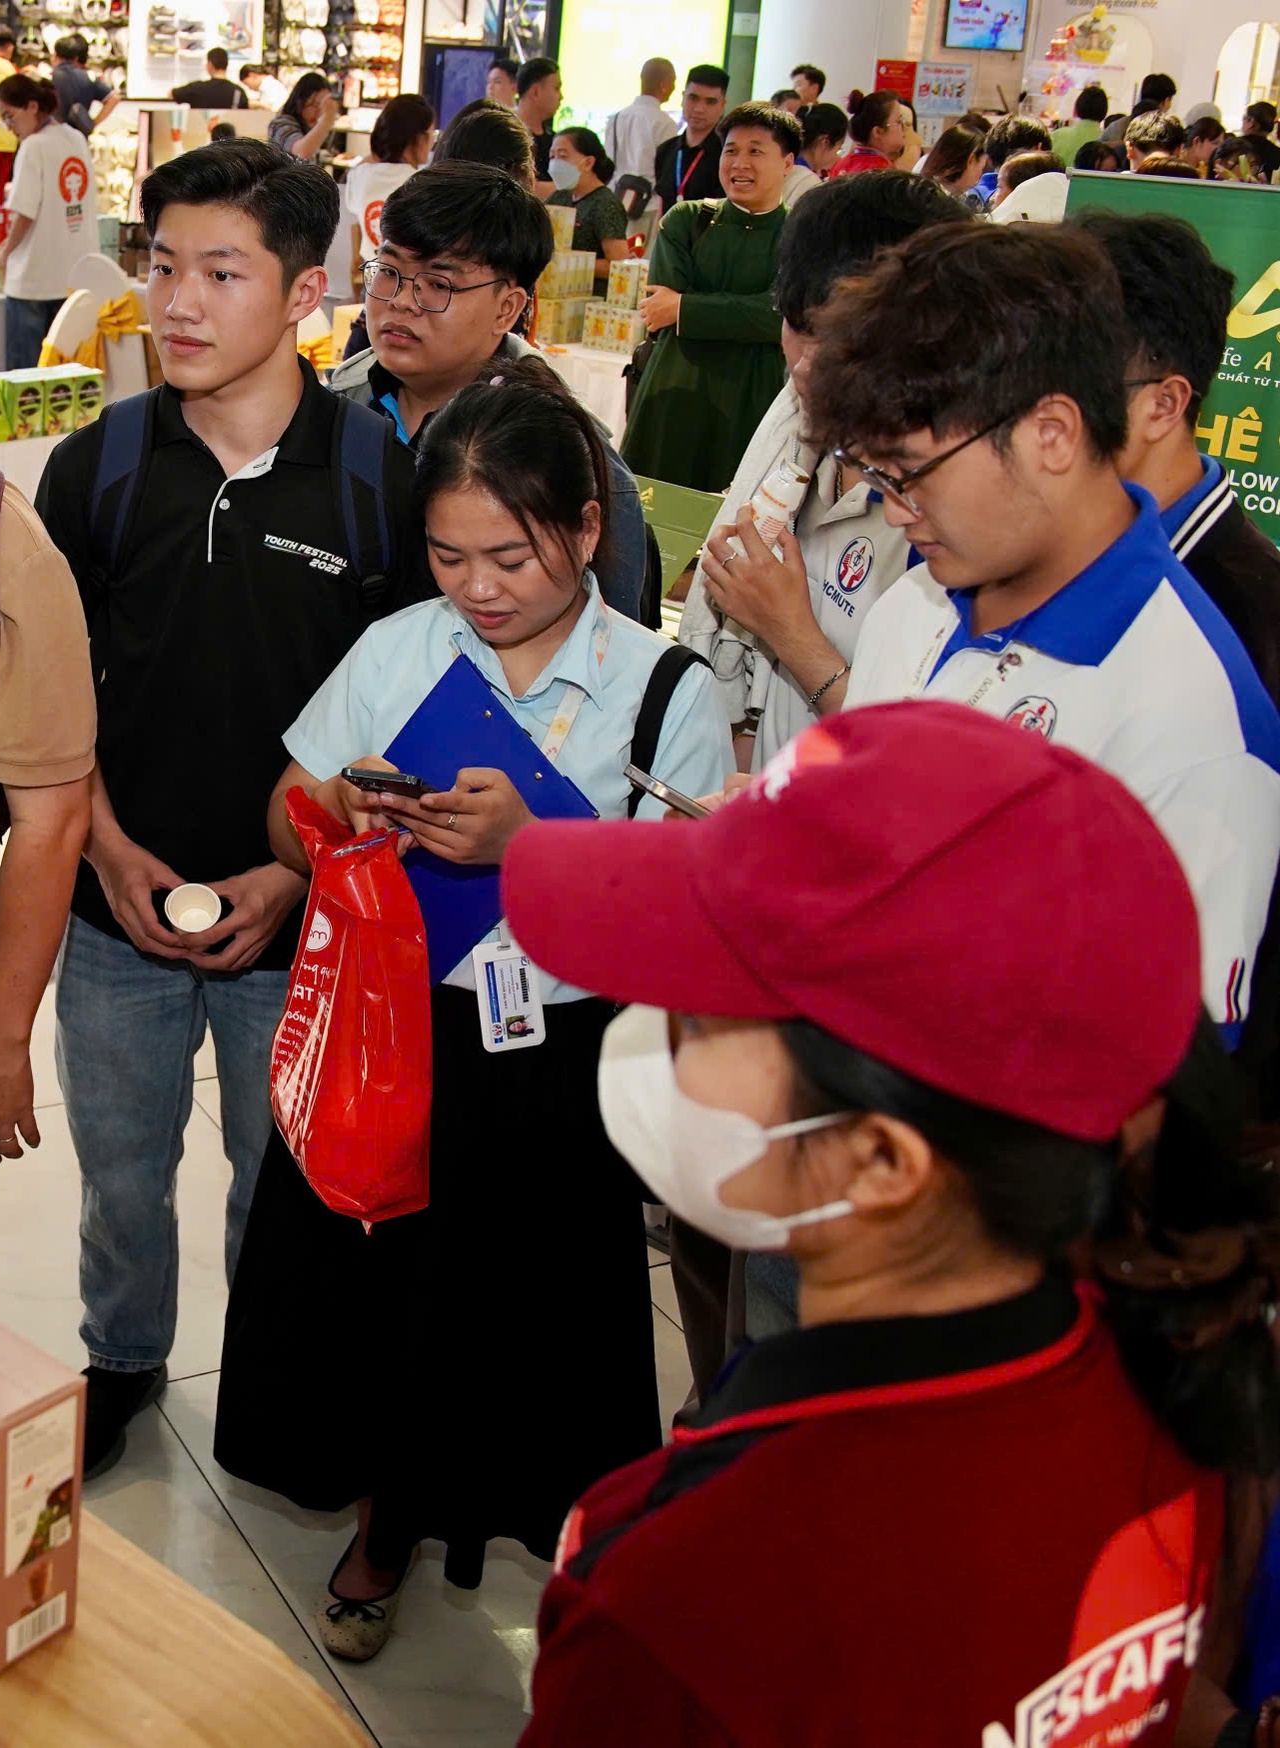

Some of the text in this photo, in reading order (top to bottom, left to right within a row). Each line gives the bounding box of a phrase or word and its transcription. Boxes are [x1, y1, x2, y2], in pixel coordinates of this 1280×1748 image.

[1217, 372, 1251, 385] CHẤT
[1253, 376, 1273, 387] TỪ
[264, 533, 348, 568] YOUTH FESTIVAL
[309, 557, 343, 575] 2025
[823, 579, 856, 618] HCMUTE
